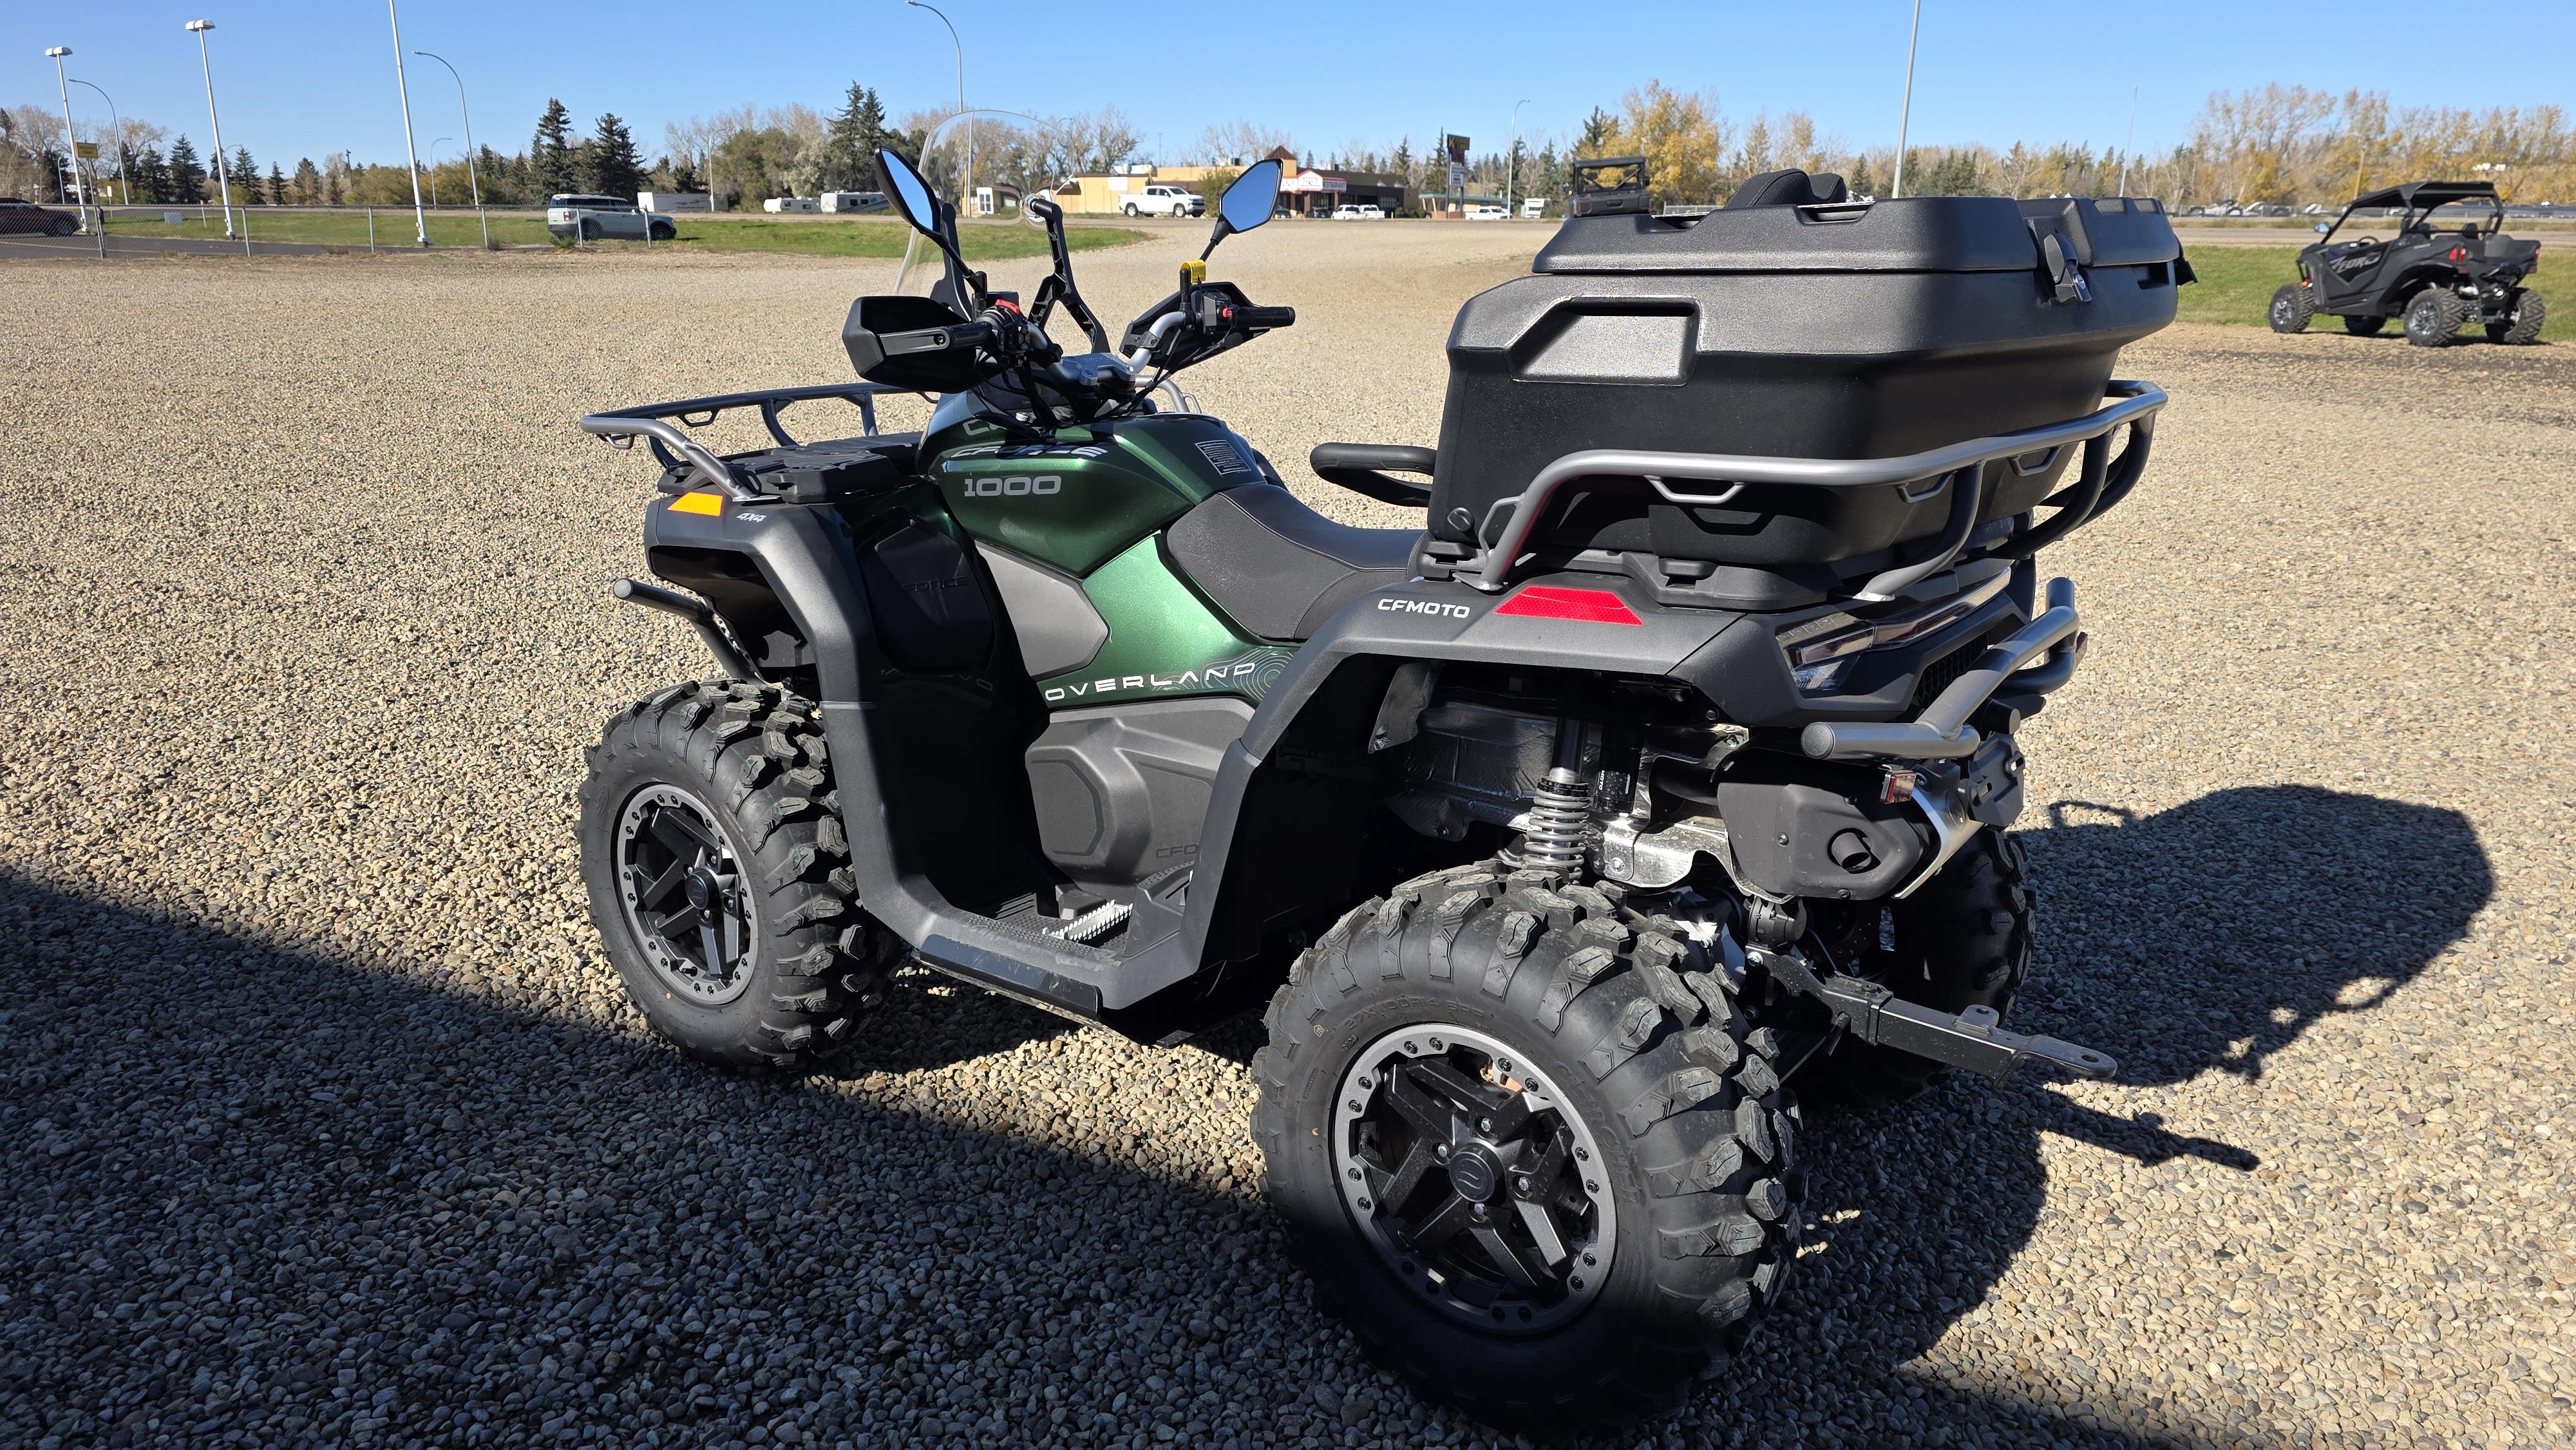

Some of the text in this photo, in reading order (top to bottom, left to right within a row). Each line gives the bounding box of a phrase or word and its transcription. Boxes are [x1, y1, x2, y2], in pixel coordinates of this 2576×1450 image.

[964, 475, 1062, 497] 1000
[1378, 598, 1470, 619] CFMOTO
[1045, 662, 1256, 702] OVERLAND
